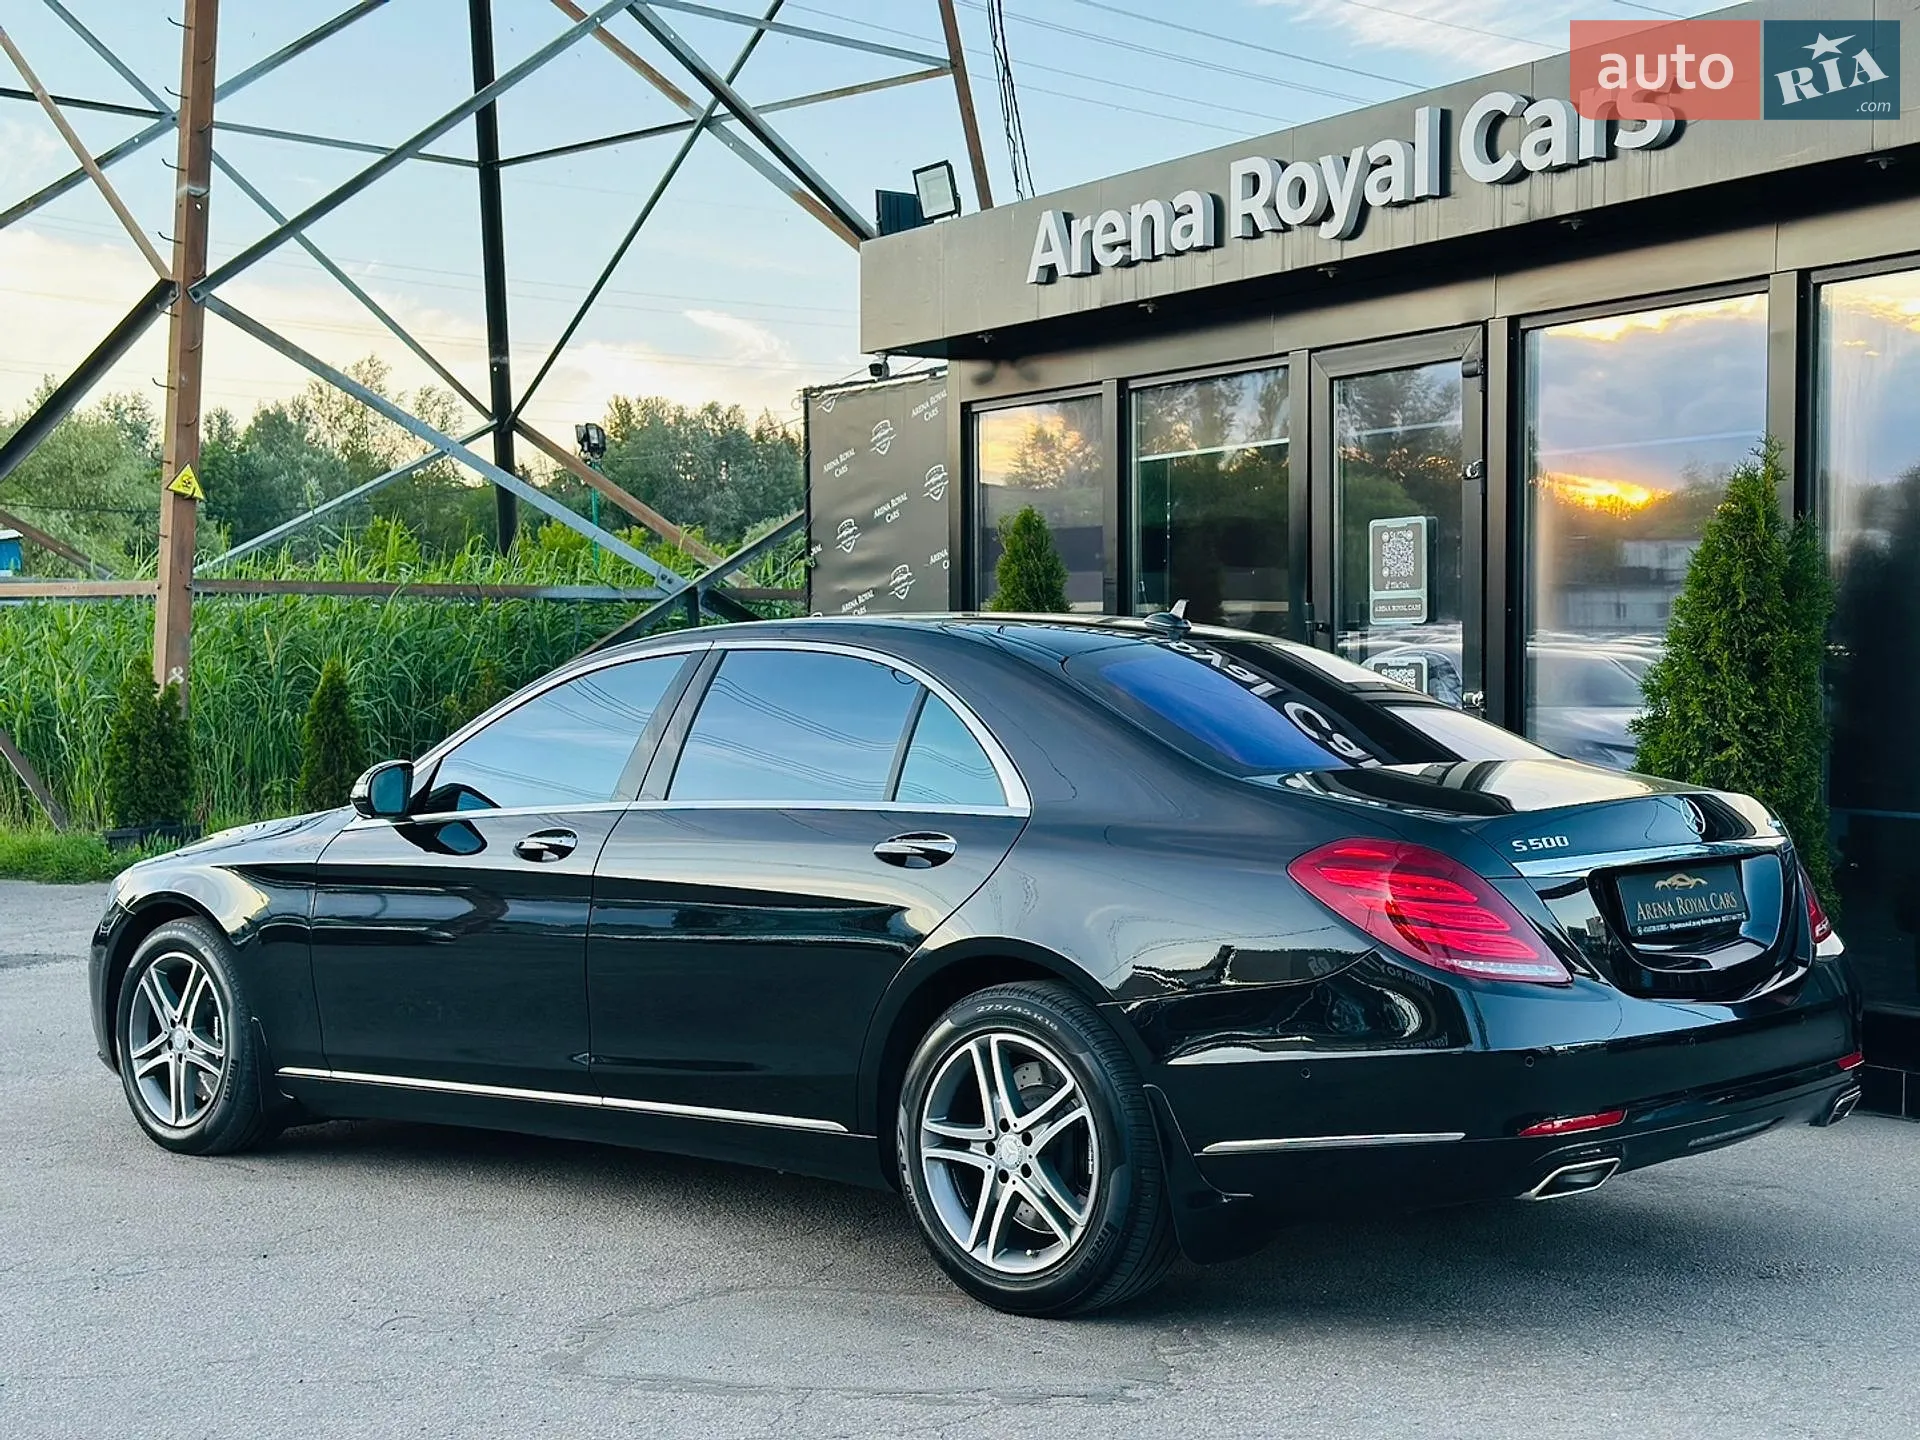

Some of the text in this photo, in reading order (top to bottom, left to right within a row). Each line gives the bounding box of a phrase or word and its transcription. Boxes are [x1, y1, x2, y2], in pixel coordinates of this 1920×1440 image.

[1027, 72, 1677, 284] Arena Royal Cars
[1511, 835, 1570, 852] S 500
[1637, 891, 1738, 921] ARENA ROYAL CARS
